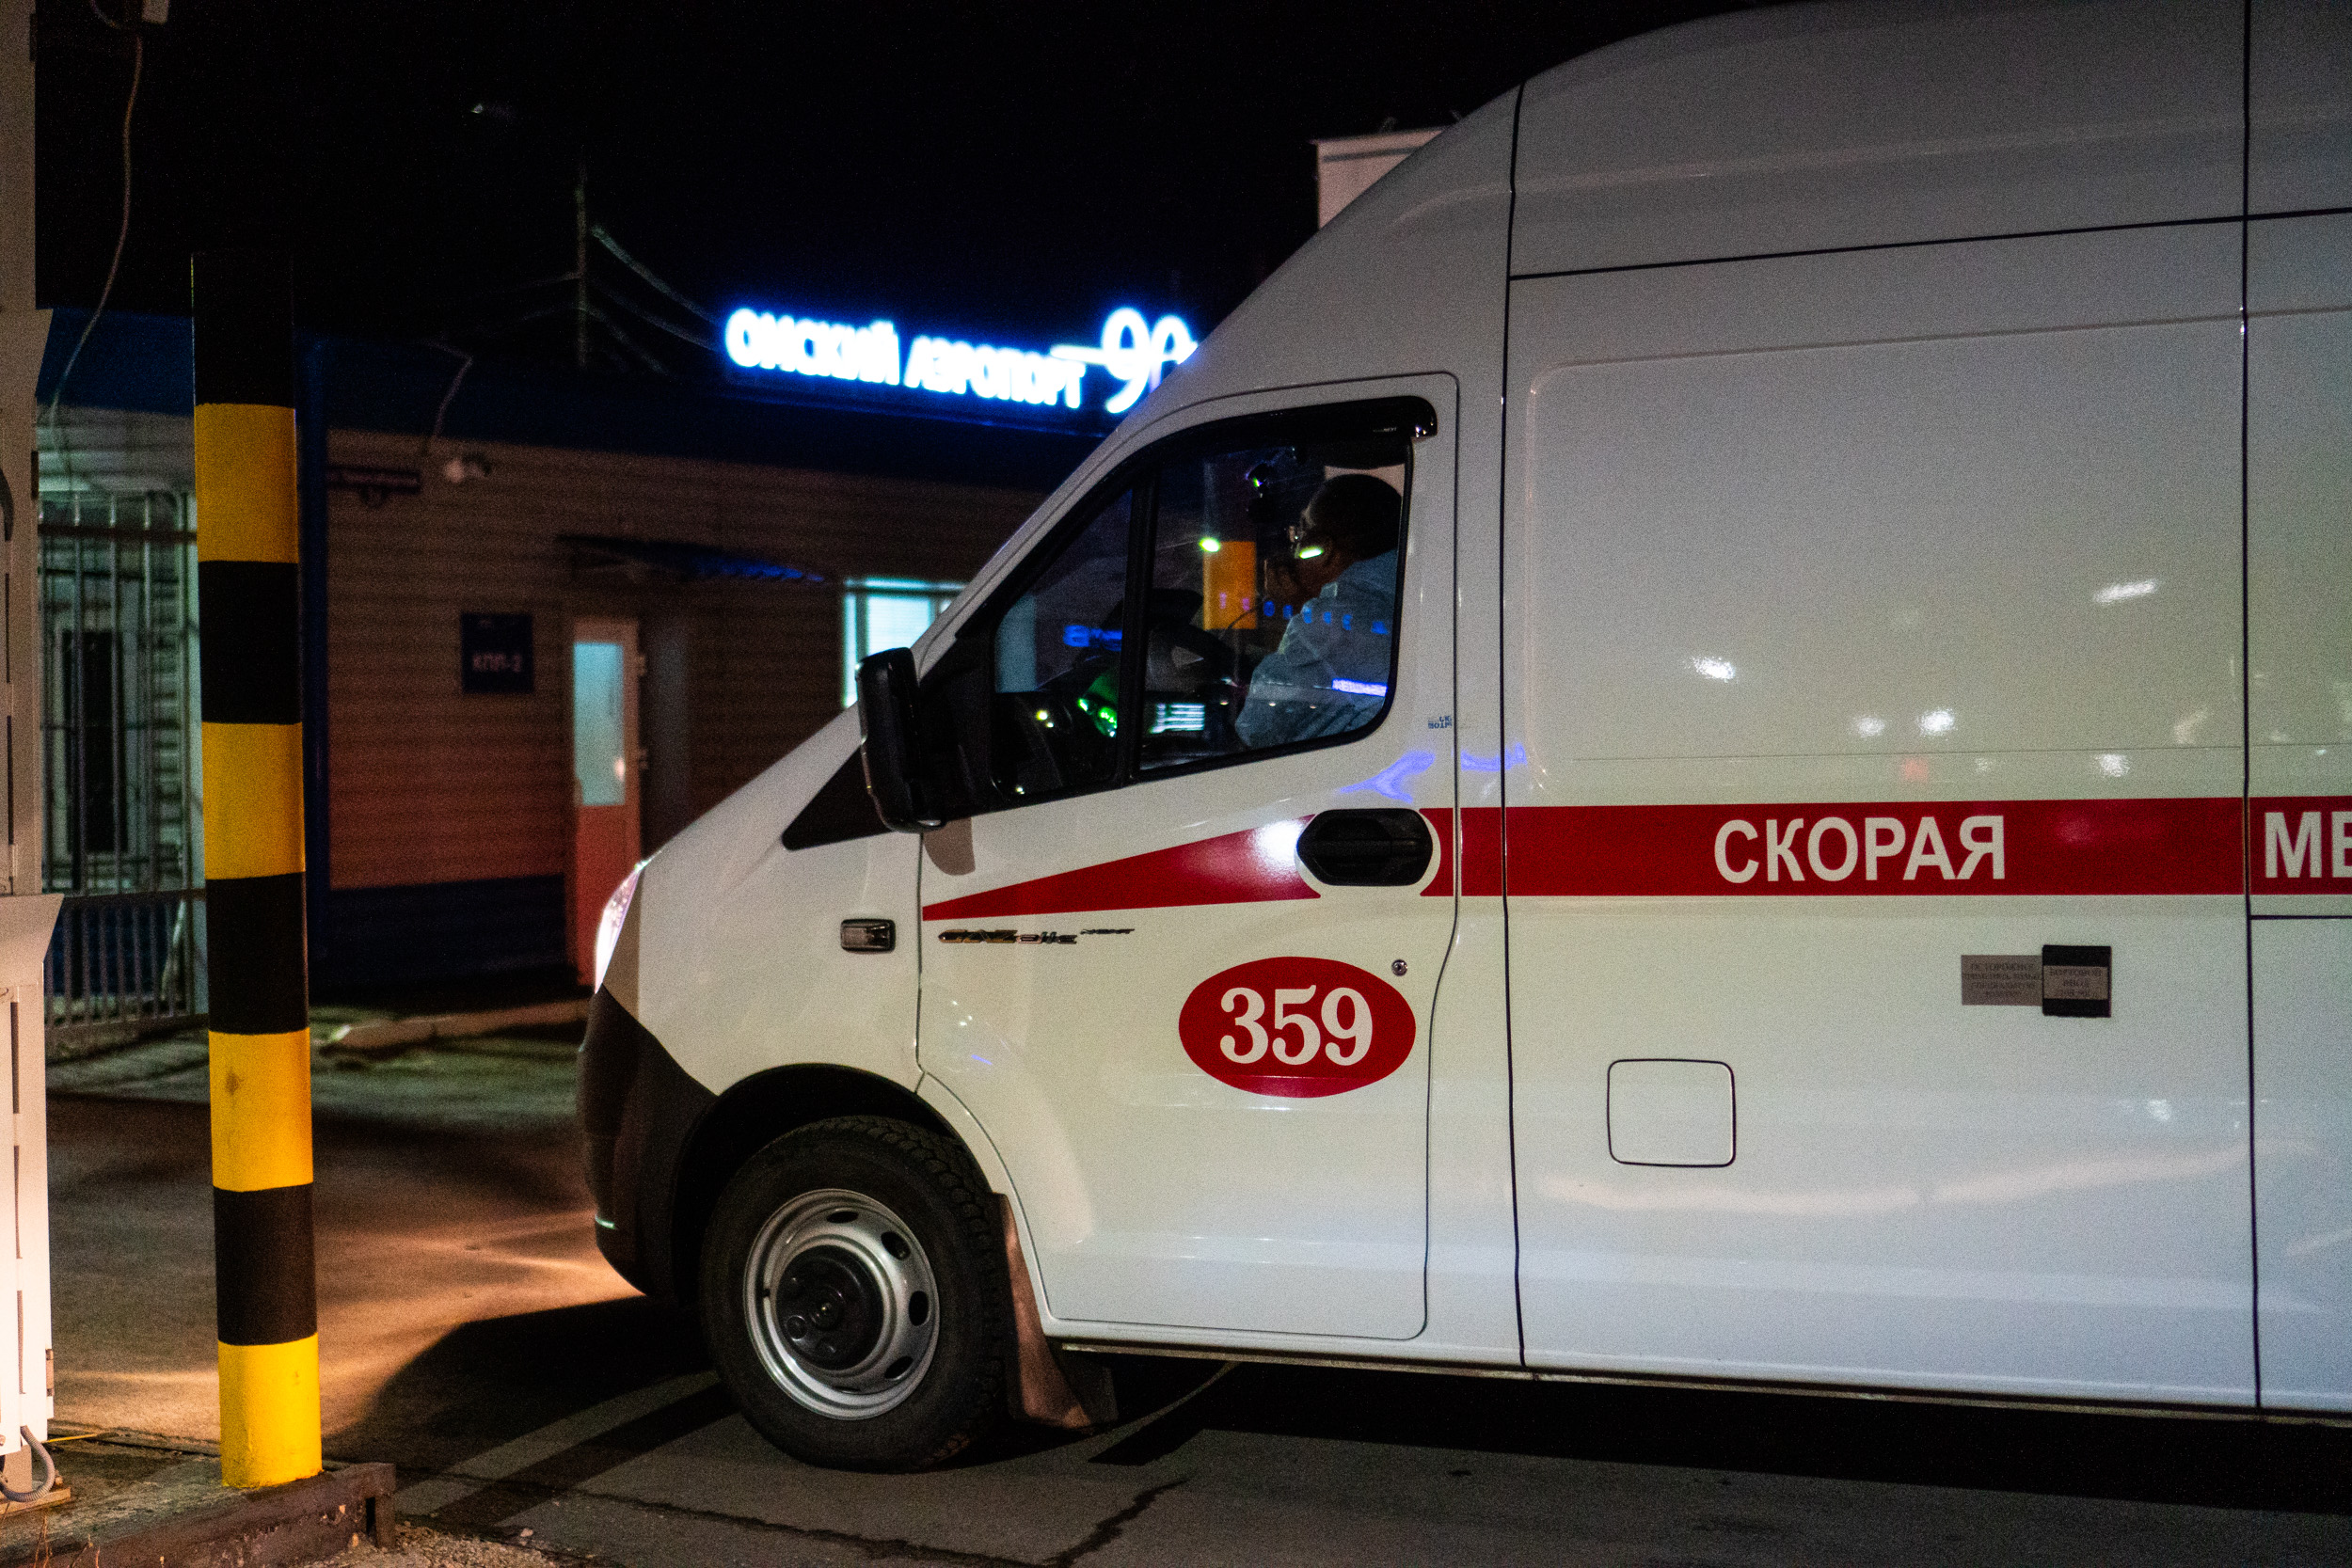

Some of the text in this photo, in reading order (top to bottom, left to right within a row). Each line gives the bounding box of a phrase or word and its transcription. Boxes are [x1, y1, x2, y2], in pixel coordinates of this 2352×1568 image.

[725, 309, 1087, 408] ОМСКИЙ АЭРОПОРТ
[1713, 815, 2006, 884] СКОРАЯ
[1219, 984, 1374, 1067] 359
